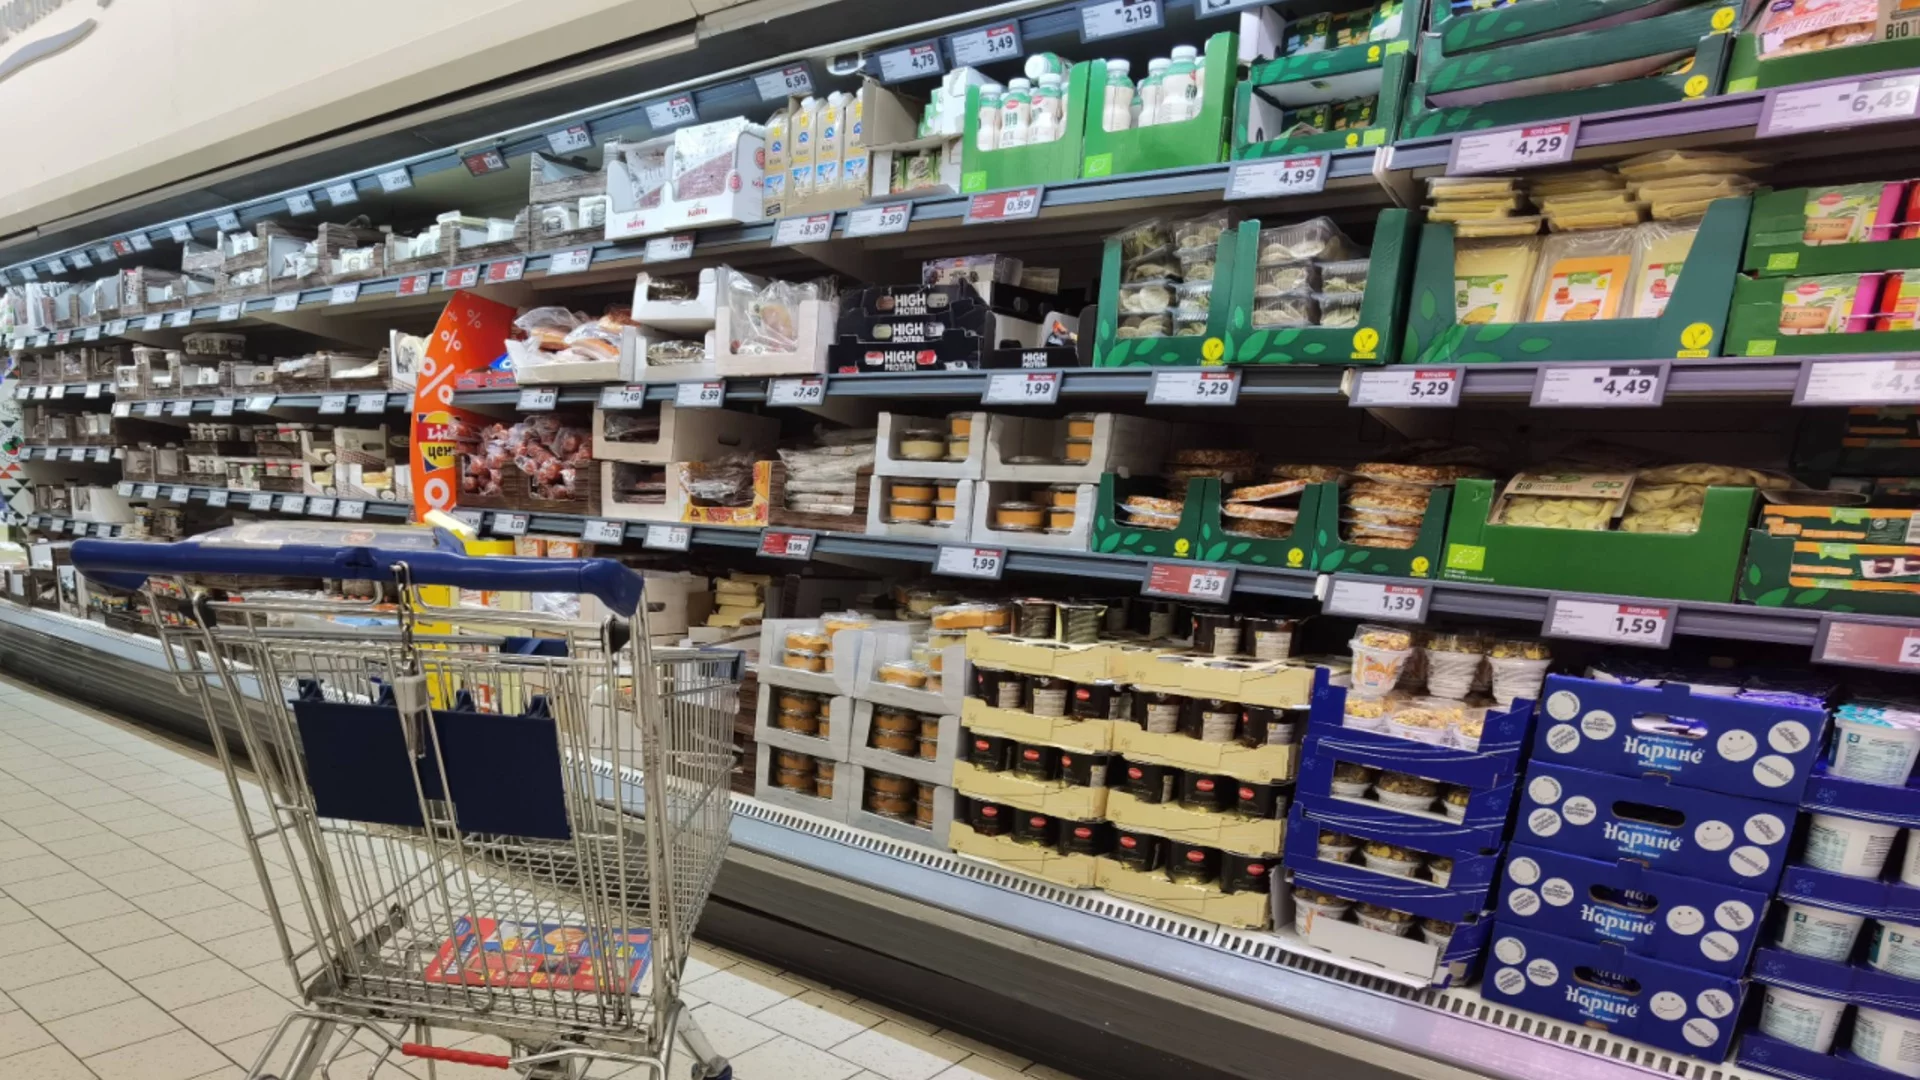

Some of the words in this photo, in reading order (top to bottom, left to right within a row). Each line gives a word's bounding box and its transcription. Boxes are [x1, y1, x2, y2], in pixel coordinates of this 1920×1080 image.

[1126, 5, 1152, 23] 2,19
[987, 35, 1013, 53] 3,49
[912, 53, 934, 69] 4,79
[785, 75, 807, 89] 6,99
[1851, 89, 1912, 114] 6,49
[672, 104, 690, 118] 5,99
[569, 133, 587, 144] 7,49
[1516, 136, 1561, 158] 4,29
[1279, 169, 1315, 185] 4,99
[1007, 199, 1030, 212] 0,99
[880, 214, 902, 227] 3,99
[894, 294, 926, 307] HIGH
[894, 307, 927, 315] PROTEIN
[892, 322, 924, 335] HIGH
[892, 335, 924, 343] PROTEIN
[884, 351, 916, 363] HIGH
[1022, 352, 1048, 361] HIGH
[799, 387, 820, 398] 7,49
[1025, 383, 1050, 396] 1,99
[1197, 382, 1229, 396] 5,29
[1410, 381, 1449, 398] 5,29
[1603, 379, 1652, 397] 4,49
[623, 392, 640, 402] 7,49
[700, 390, 719, 401] 6,99
[427, 446, 456, 460] цен
[972, 557, 995, 571] 1,99
[1193, 578, 1220, 591] 2,39
[1382, 595, 1415, 611] 1,39
[1615, 617, 1657, 635] 1,59
